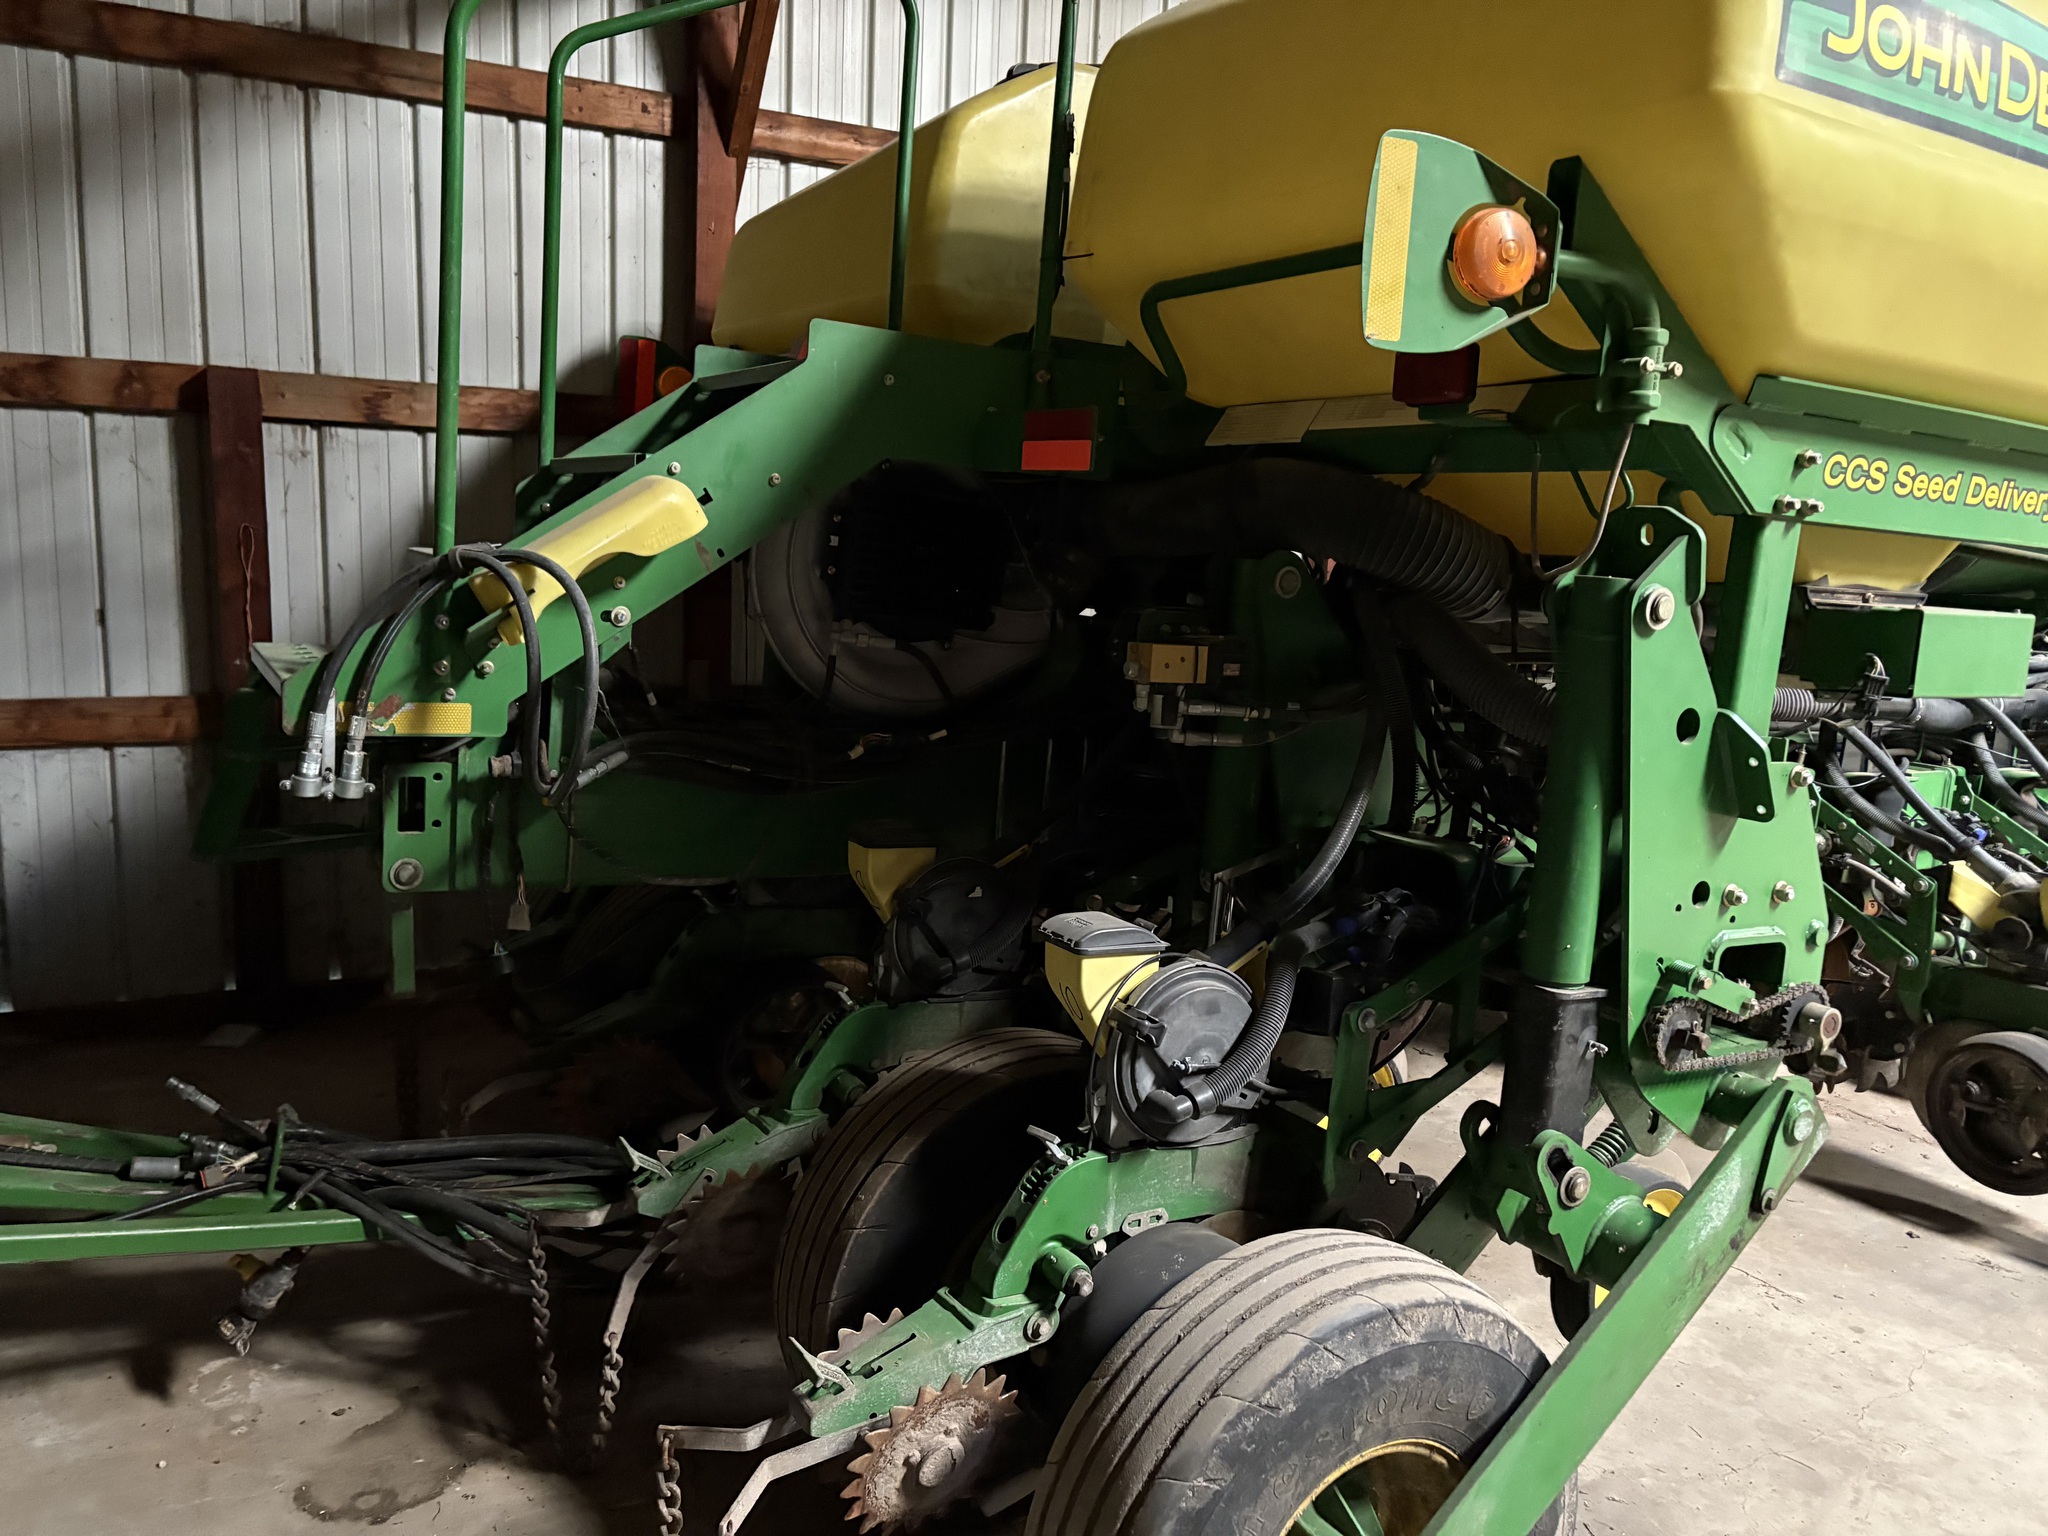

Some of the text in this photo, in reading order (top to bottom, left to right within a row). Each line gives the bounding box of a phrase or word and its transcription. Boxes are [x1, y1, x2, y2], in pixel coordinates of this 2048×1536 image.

[1825, 0, 1992, 107] JOHN
[1823, 453, 2048, 522] CCS Seed Deliver
[1058, 981, 1084, 1021] 10
